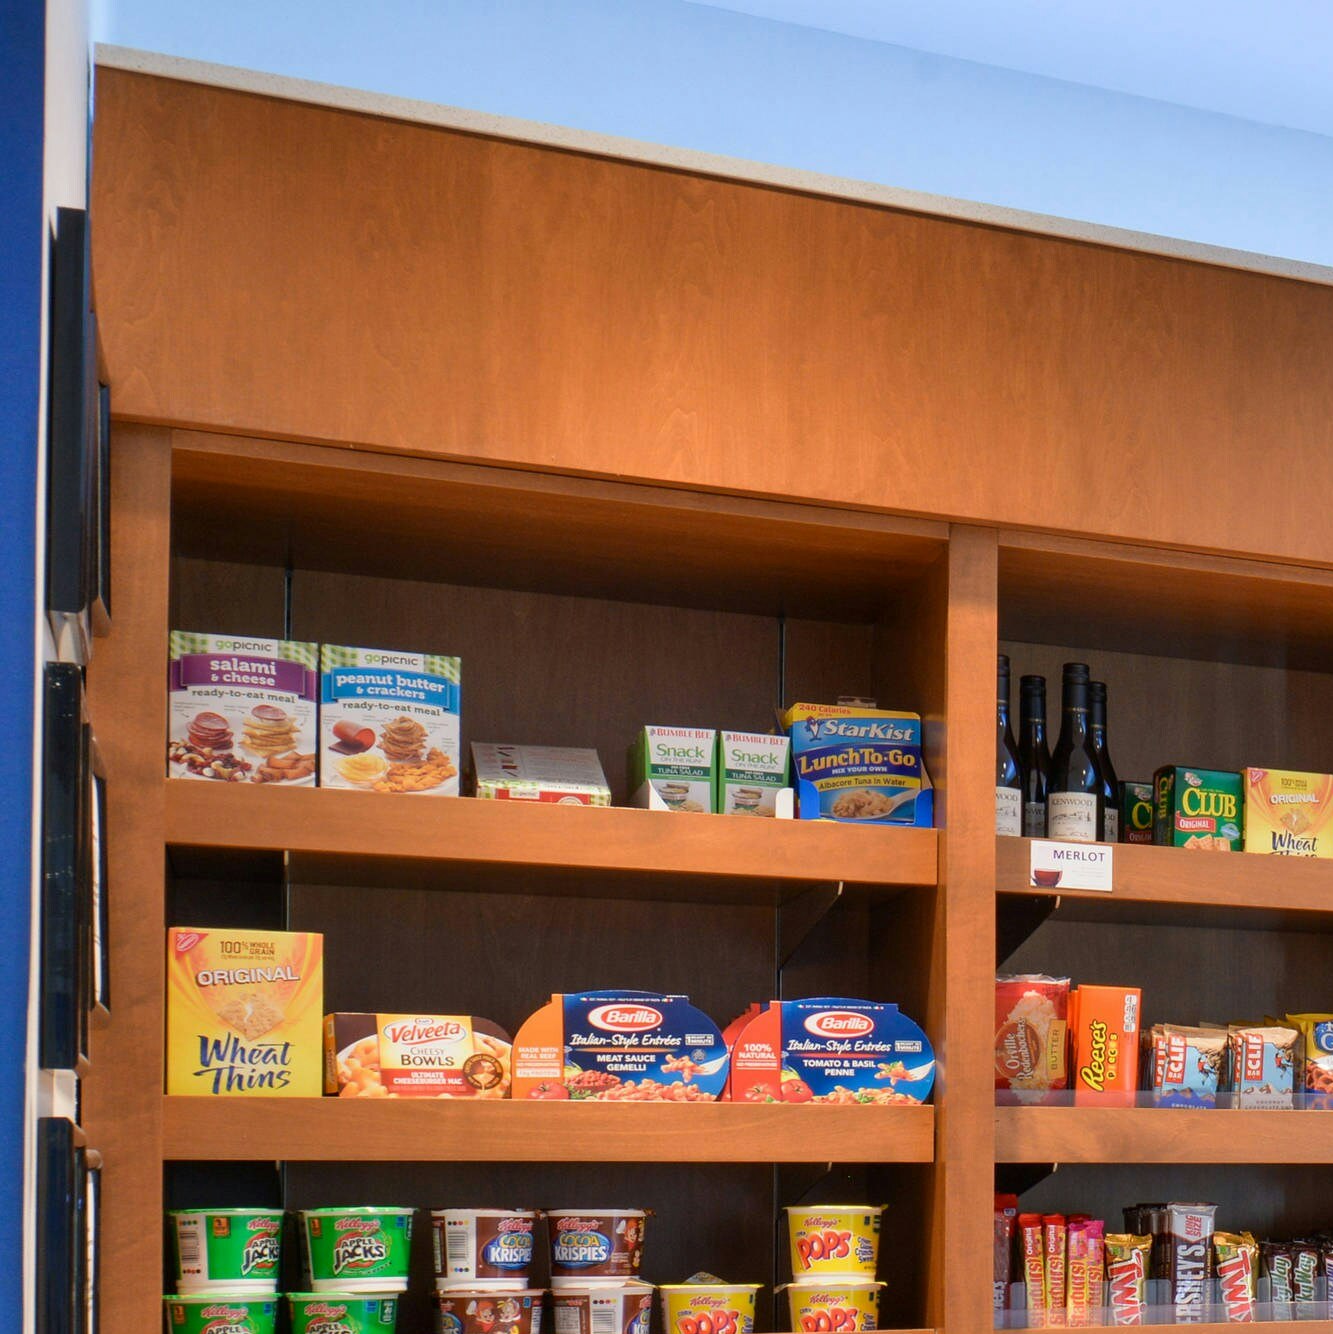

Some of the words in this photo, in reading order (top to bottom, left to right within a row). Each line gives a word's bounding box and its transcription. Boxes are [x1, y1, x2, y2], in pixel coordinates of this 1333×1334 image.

[215, 639, 272, 653] gopicnic
[210, 657, 276, 676] salami
[364, 653, 419, 667] gopicnic
[211, 674, 219, 683] &
[222, 672, 276, 687] cheese
[336, 672, 394, 688] peanut
[396, 675, 445, 693] butter
[191, 688, 265, 701] ready-to-eat
[267, 692, 296, 704] meal
[356, 686, 364, 694] &
[367, 684, 425, 701] crackers
[342, 701, 411, 714] ready-to-eat
[413, 705, 441, 717] meal
[823, 719, 915, 742] StarKist
[657, 743, 706, 760] Snack
[732, 748, 779, 766] Snack
[853, 778, 871, 788] Tuna
[1183, 788, 1236, 817] CLUB
[1271, 793, 1319, 805] ORIGINAL
[1180, 819, 1209, 829] ORIGINAL
[1272, 830, 1319, 853] Wheat
[1054, 850, 1105, 862] MERLOT
[196, 967, 300, 986] ORIGINAL
[608, 1010, 657, 1026] Barilla
[822, 1016, 870, 1033] Barilla
[389, 1022, 461, 1043] Velveeta
[570, 1034, 640, 1048] Italian-Style
[643, 1034, 681, 1046] Entrées
[787, 1040, 851, 1053] Italian-Style
[854, 1040, 891, 1052] Entrées
[198, 1032, 295, 1067] Wheat
[410, 1046, 446, 1056] CHEESY
[738, 1051, 776, 1060] NATURAL
[1051, 1029, 1060, 1070] BUTTER
[1081, 1020, 1108, 1091] Reese's
[1170, 1037, 1185, 1072] CLIF
[1248, 1034, 1261, 1070] CLIF
[401, 1053, 455, 1067] BOWLS
[597, 1054, 622, 1062] MEAT
[625, 1054, 655, 1063] SAUCE
[803, 1060, 838, 1068] TOMATO
[849, 1061, 876, 1069] BASIL
[607, 1063, 646, 1071] GEMELLI
[825, 1068, 854, 1077] PENNE
[194, 1065, 291, 1094] Thins
[341, 1238, 375, 1247] APPLE
[559, 1234, 599, 1246] COCOA
[334, 1243, 386, 1272] JACKS
[554, 1245, 608, 1262] KRISPIES
[799, 1230, 851, 1269] POPS
